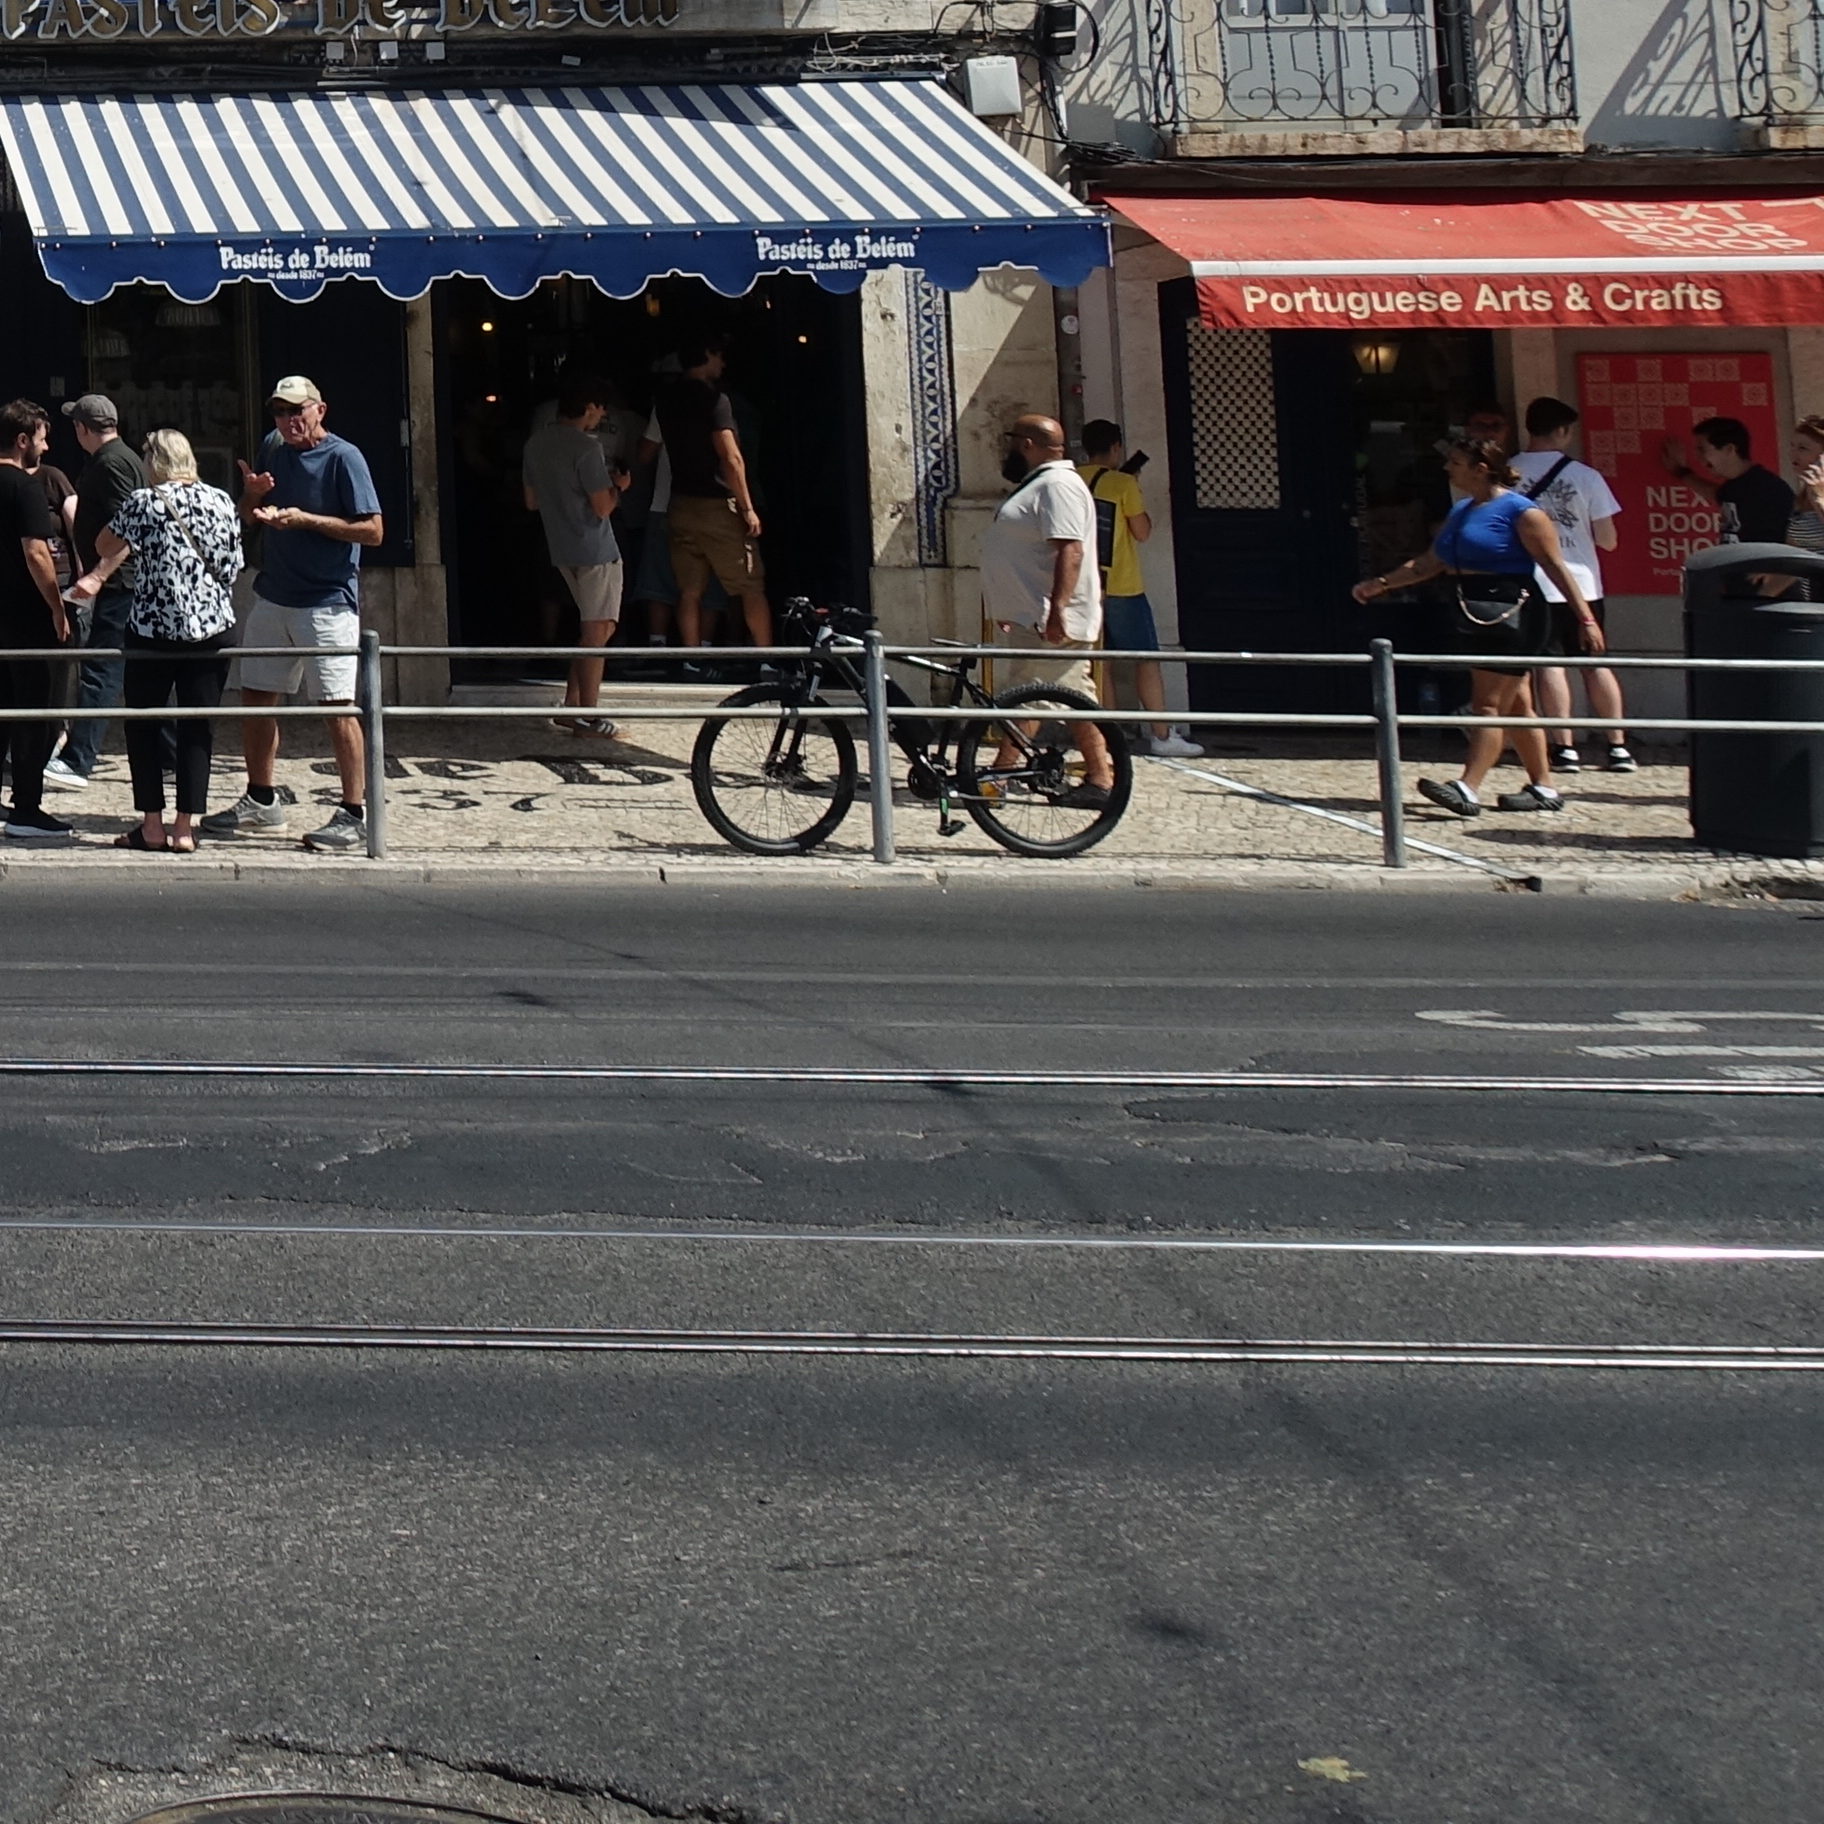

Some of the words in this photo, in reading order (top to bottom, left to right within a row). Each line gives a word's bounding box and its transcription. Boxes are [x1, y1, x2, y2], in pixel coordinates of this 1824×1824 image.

[1573, 200, 1747, 221] NEXT
[1598, 219, 1790, 238] DOOR
[756, 236, 824, 261] Pastéis
[828, 238, 851, 260] de
[854, 235, 916, 258] Belém
[1624, 234, 1808, 251] SHOP
[220, 246, 284, 270] Pastéis
[288, 248, 310, 268] de
[314, 245, 372, 268] Belém
[816, 261, 838, 270] desde
[840, 260, 858, 270] 1837
[276, 270, 298, 280] desde
[299, 270, 317, 280] 1837
[1242, 285, 1462, 320] Portuguese
[1474, 283, 1552, 312] Arts
[1564, 283, 1592, 311] &
[1603, 282, 1723, 311] Crafts
[1646, 485, 1711, 507] NEX
[1649, 537, 1720, 559] SHO
